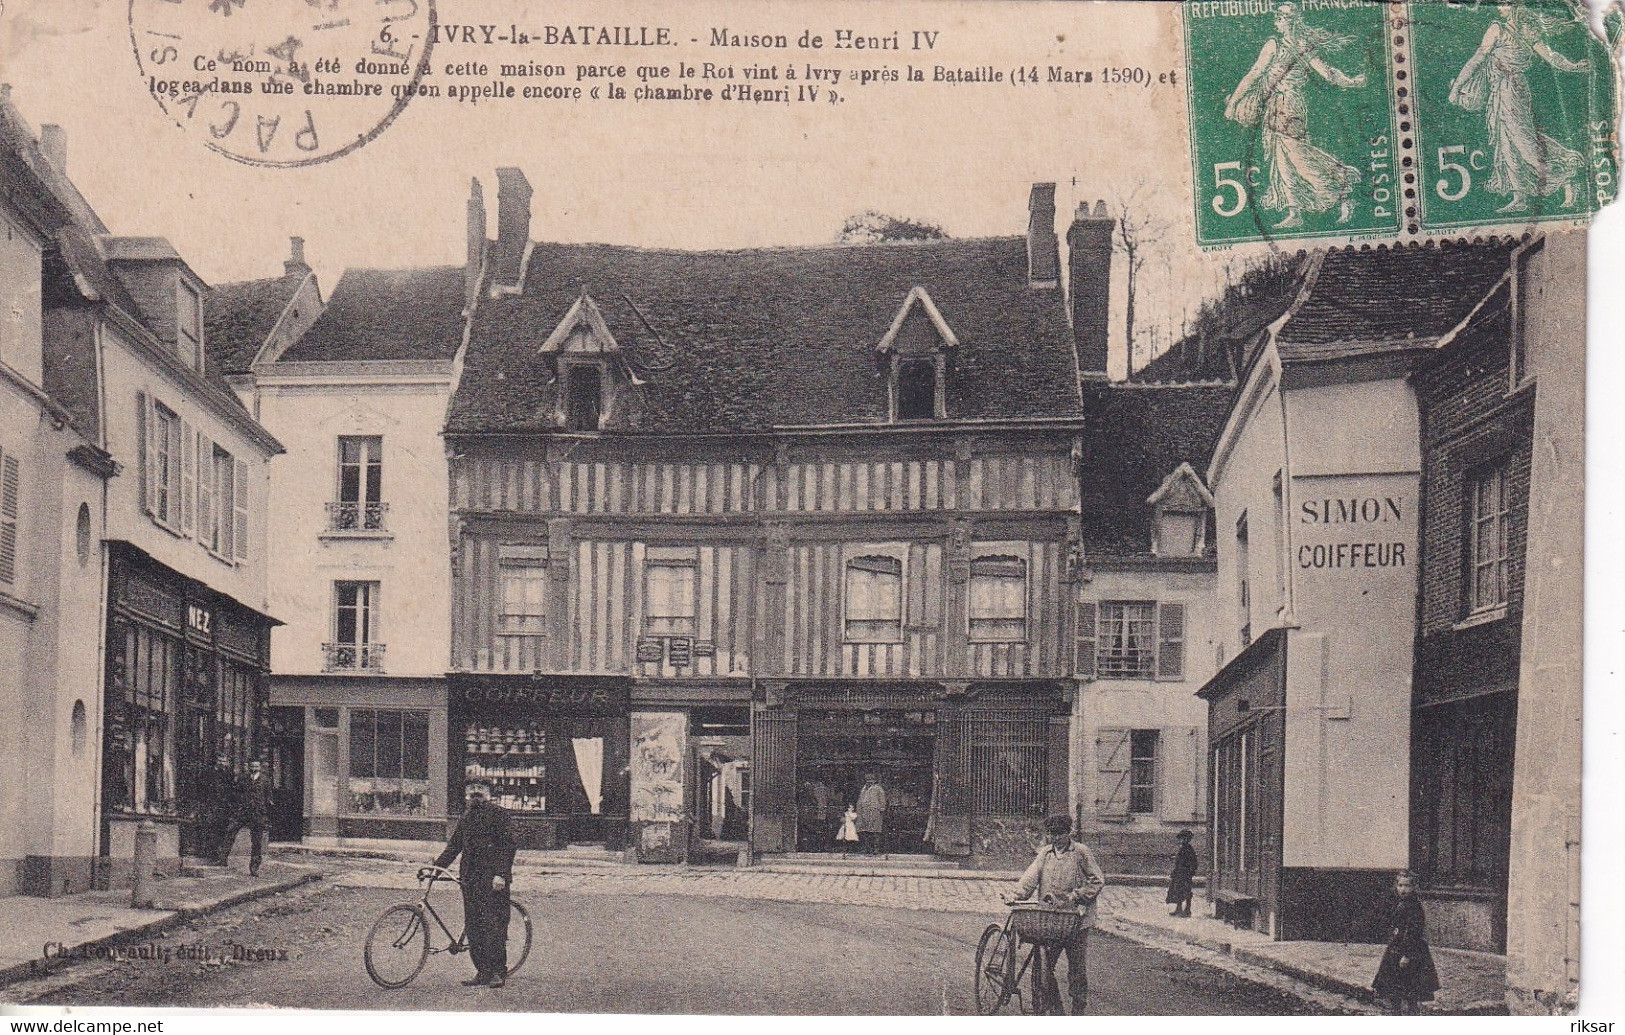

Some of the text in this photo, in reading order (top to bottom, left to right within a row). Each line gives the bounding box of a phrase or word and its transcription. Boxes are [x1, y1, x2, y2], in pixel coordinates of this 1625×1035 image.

[379, 25, 399, 43] 6.
[431, 25, 678, 47] IVRY-la-BATAILLE.
[710, 28, 788, 49] Maison
[797, 30, 822, 49] de
[835, 30, 899, 49] Henri
[911, 31, 939, 50] IV
[194, 56, 216, 71] Ce
[232, 60, 271, 72] nom
[289, 61, 299, 73] a
[315, 57, 341, 73] été
[356, 57, 410, 75] donné
[445, 61, 488, 76] cette
[500, 61, 565, 77] maison
[576, 66, 626, 82] parce
[636, 66, 671, 82] que
[679, 61, 696, 79] le
[703, 62, 734, 79] Roi
[743, 63, 778, 80] vint
[786, 64, 797, 80] à
[806, 64, 842, 83] Ivry
[850, 66, 899, 84] après
[907, 65, 924, 82] la
[933, 65, 1003, 84] Bataille
[1010, 66, 1039, 85] (14
[1048, 66, 1094, 84] Mars
[1102, 67, 1151, 87] 1590)
[1159, 71, 1177, 86] et
[150, 77, 198, 97] logea
[210, 77, 252, 94] dans
[262, 81, 294, 95] une
[304, 79, 382, 96] chambre
[448, 81, 515, 102] appelle
[523, 84, 581, 99] encore
[609, 82, 627, 99] la
[635, 83, 712, 101] chambre
[721, 84, 790, 105] d'Henri
[797, 84, 820, 102] IV
[1370, 137, 1391, 218] POSTES
[1301, 497, 1402, 524] SIMON
[1298, 541, 1405, 568] COIFFEUR
